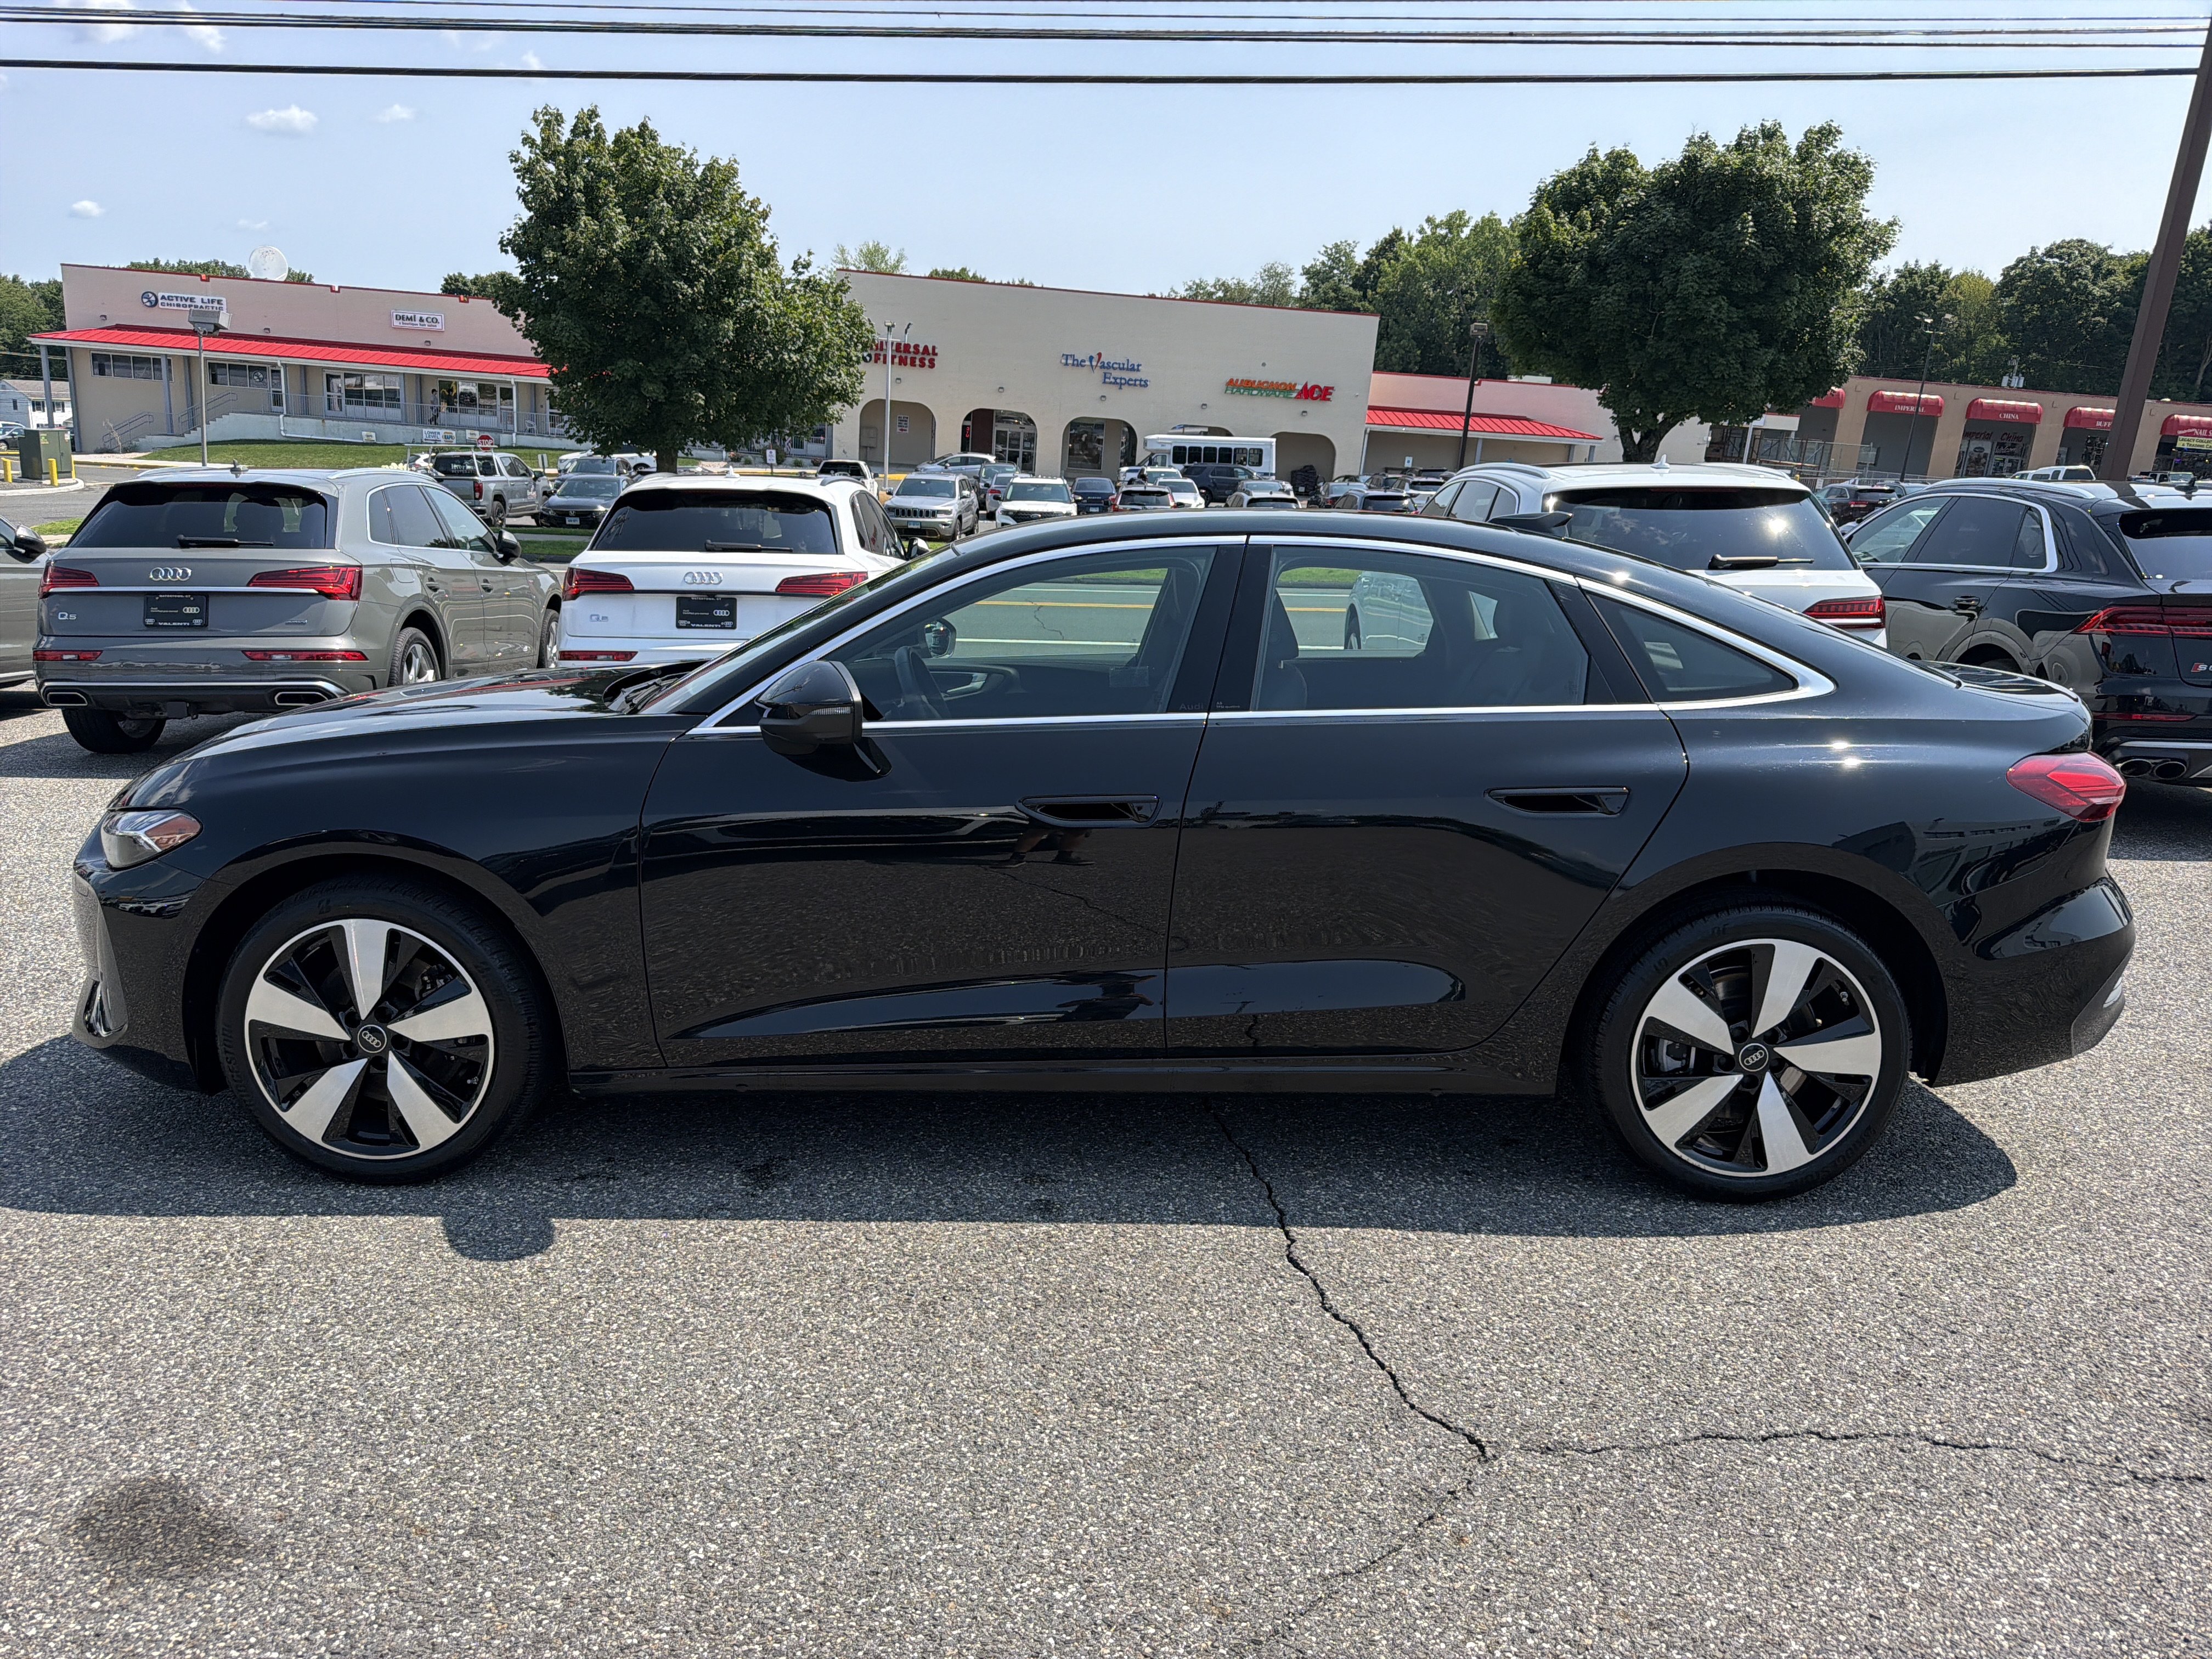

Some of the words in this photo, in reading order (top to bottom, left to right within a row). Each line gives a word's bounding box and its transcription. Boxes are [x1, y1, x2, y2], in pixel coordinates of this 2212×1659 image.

[160, 302, 224, 311] CHIROPRACTIC
[870, 340, 938, 356] IVERSAL
[874, 353, 936, 369] FITNESS
[1062, 353, 1087, 368] The
[1088, 352, 1142, 374] Vascular
[1102, 371, 1149, 390] Experts
[1224, 386, 1296, 399] HARDWARE
[1226, 377, 1297, 391] AUBUCHON
[1295, 381, 1334, 402] ACE
[1894, 404, 1926, 413] IMPERIAL
[58, 612, 77, 620] Q5
